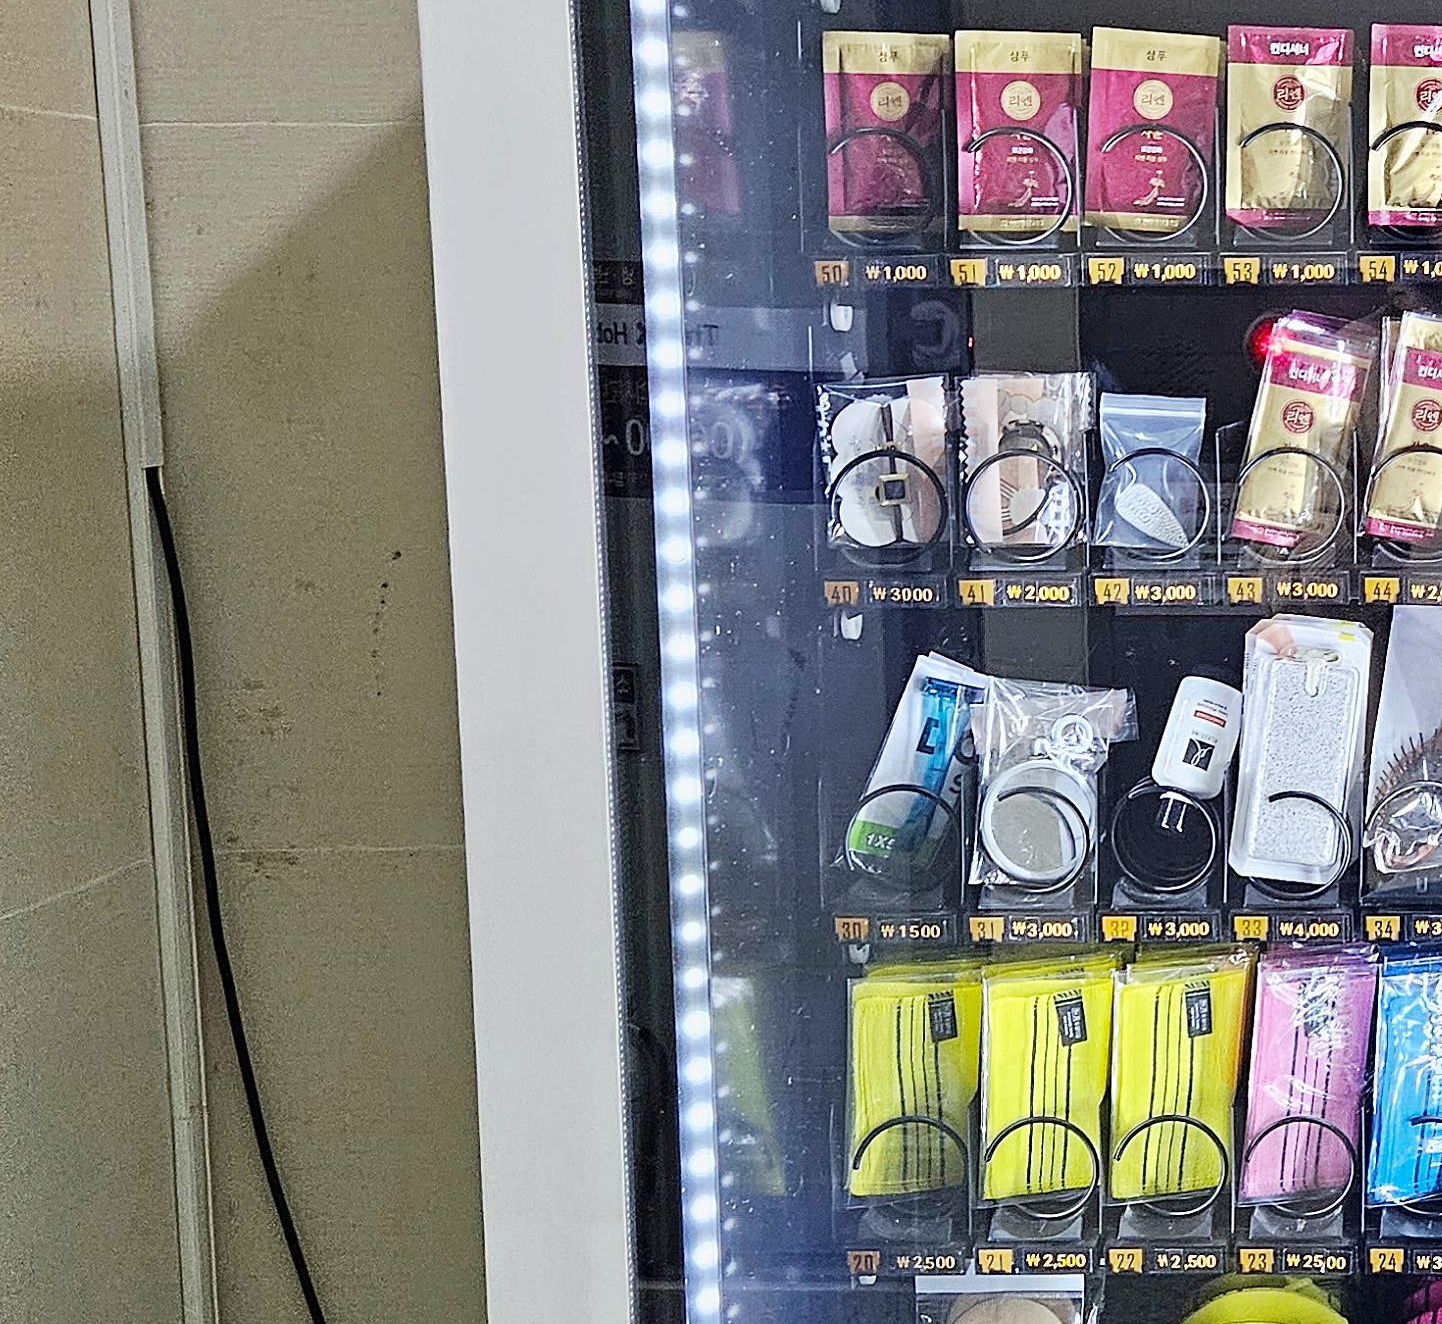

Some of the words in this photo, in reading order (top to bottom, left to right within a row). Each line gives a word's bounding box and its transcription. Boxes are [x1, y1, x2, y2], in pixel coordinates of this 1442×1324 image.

[1010, 51, 1029, 62] 샴푸
[1147, 50, 1166, 61] 샴푸
[865, 263, 928, 282] ₩1,000
[999, 263, 1062, 282] ₩1,000
[1134, 262, 1197, 281] ₩1,000
[1272, 262, 1336, 281] ₩1,000
[1005, 584, 1069, 603] ₩2,000
[1135, 583, 1197, 603] ₩3,000
[1276, 581, 1339, 601] ₩3,000
[1011, 919, 1072, 938] ₩3,000
[1147, 920, 1211, 938] ₩3,000
[1278, 920, 1340, 939] ₩4,000
[896, 1254, 957, 1270] ₩2,500
[1025, 1253, 1088, 1270] ₩2,500
